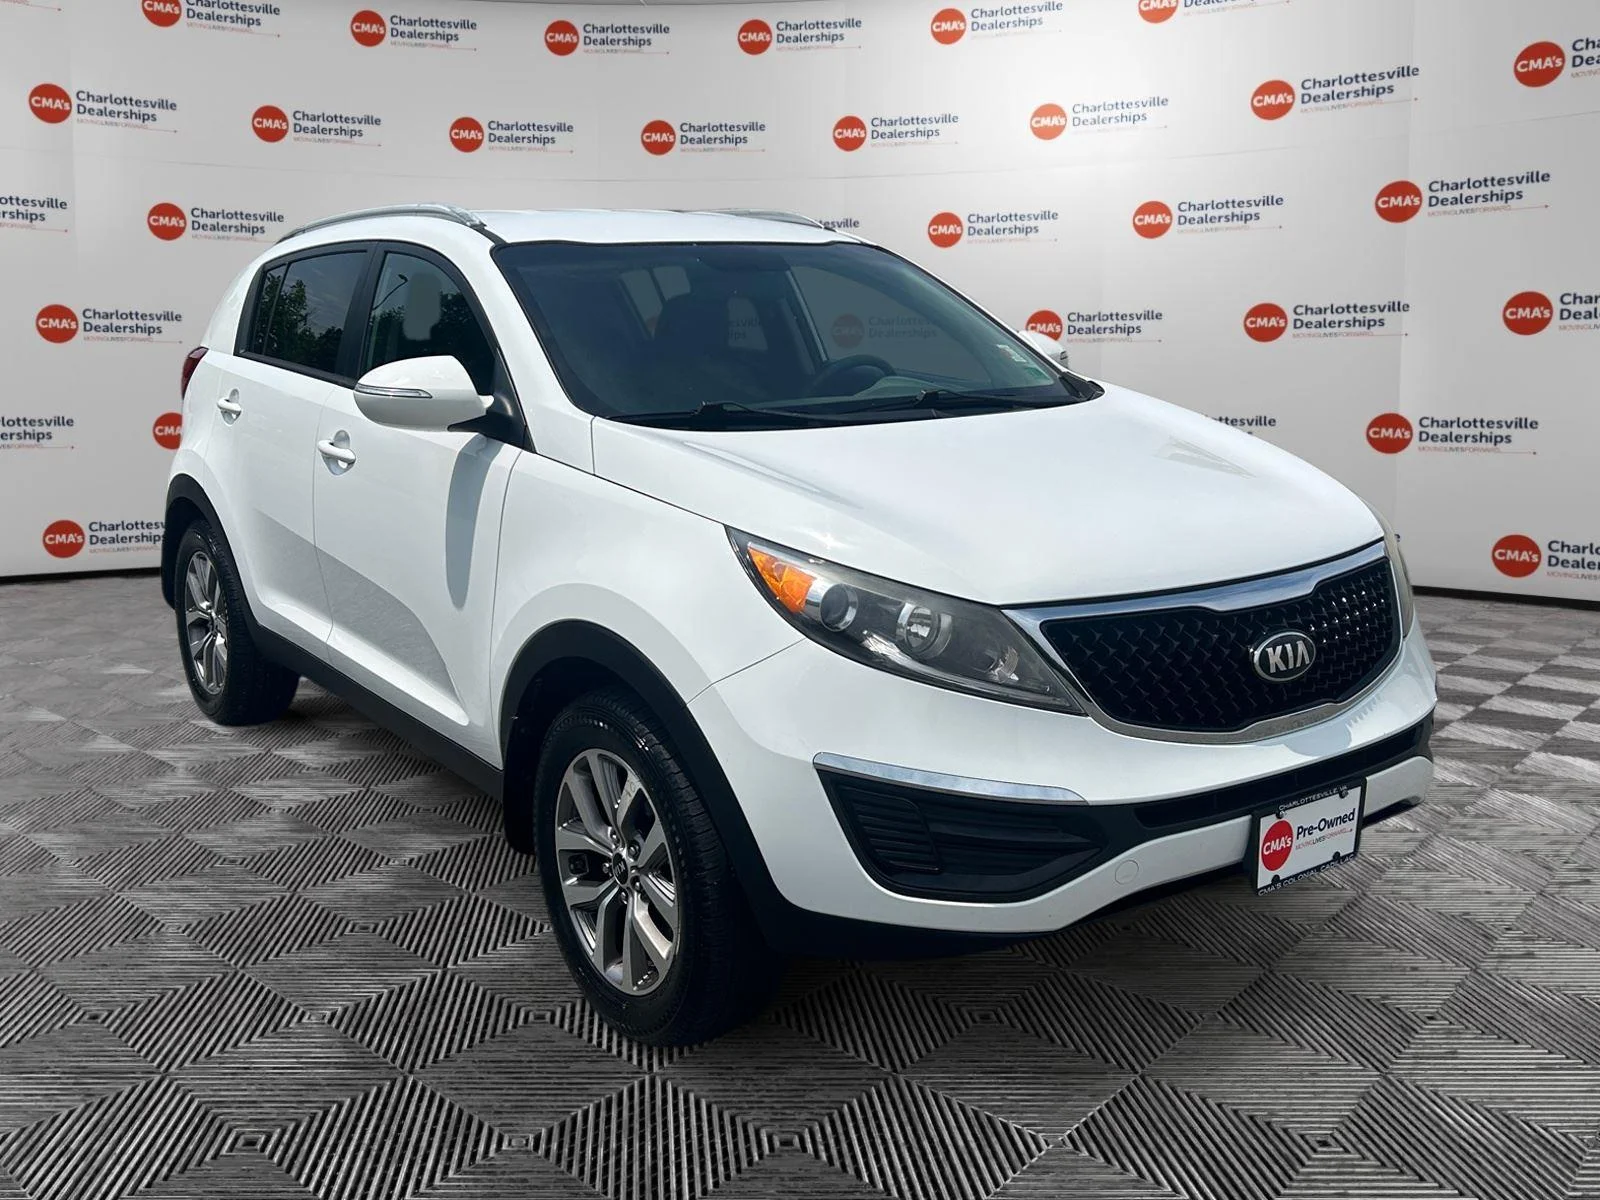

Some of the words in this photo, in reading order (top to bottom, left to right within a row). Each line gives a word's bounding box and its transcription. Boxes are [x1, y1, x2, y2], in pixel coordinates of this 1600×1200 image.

[143, 0, 180, 15] CMA's
[971, 1, 1063, 19] Charlottesville
[187, 8, 261, 27] Dealerships
[390, 15, 477, 31] Charlottesville
[971, 15, 1043, 32] Dealerships
[352, 22, 385, 34] CMA's
[583, 23, 670, 35] Charlottesville
[776, 17, 862, 35] Charlottesville
[932, 20, 966, 33] CMA's
[390, 27, 459, 43] Dealerships
[546, 32, 578, 43] CMA's
[583, 34, 652, 48] Dealerships
[739, 31, 771, 43] CMA's
[776, 30, 845, 44] Dealerships
[1516, 56, 1563, 72] CMA's
[1301, 65, 1420, 90] Charlottesville
[76, 90, 177, 111] Charlottesville
[1252, 93, 1294, 107] CMA's
[1301, 83, 1394, 105] Dealerships
[30, 96, 71, 111] CMA's
[1072, 96, 1169, 115] Charlottesville
[76, 104, 157, 123] Dealerships
[293, 110, 381, 126] Charlottesville
[871, 113, 959, 128] Charlottesville
[1072, 110, 1147, 128] Dealerships
[253, 118, 288, 130] CMA's
[488, 120, 573, 133] Charlottesville
[680, 121, 766, 134] Charlottesville
[1031, 115, 1065, 127] CMA's
[293, 122, 363, 139] Dealerships
[451, 129, 482, 141] CMA's
[642, 132, 674, 143] CMA's
[835, 128, 866, 139] CMA's
[871, 126, 940, 140] Dealerships
[488, 132, 556, 146] Dealerships
[680, 133, 748, 147] Dealerships
[1428, 170, 1551, 192] Charlottesville
[1178, 195, 1284, 212] Charlottesville
[1377, 195, 1421, 209] CMA's
[1428, 188, 1523, 208] Dealerships
[150, 215, 185, 228] CMA's
[191, 208, 284, 223] Charlottesville
[967, 210, 1059, 223] Charlottesville
[1134, 213, 1172, 226] CMA's
[1178, 211, 1260, 225] Dealerships
[191, 220, 266, 236] Dealerships
[929, 225, 962, 236] CMA's
[967, 223, 1039, 237] Dealerships
[83, 308, 182, 322] Charlottesville
[1293, 300, 1410, 316] Charlottesville
[1505, 307, 1551, 319] CMA's
[1067, 309, 1163, 322] Charlottesville
[1246, 315, 1285, 328] CMA's
[38, 318, 77, 330] CMA's
[83, 321, 162, 336] Dealerships
[1027, 323, 1062, 333] CMA's
[1067, 321, 1142, 336] Dealerships
[1293, 315, 1385, 331] Dealerships
[1418, 416, 1539, 430] Charlottesville
[1368, 427, 1412, 439] CMA's
[1418, 430, 1512, 446] Dealerships
[44, 533, 83, 544] CMA's
[1494, 549, 1539, 562] CMA's
[1266, 640, 1310, 674] KIA
[1297, 808, 1355, 840] Pre-Owned
[1263, 835, 1292, 855] CMA's
